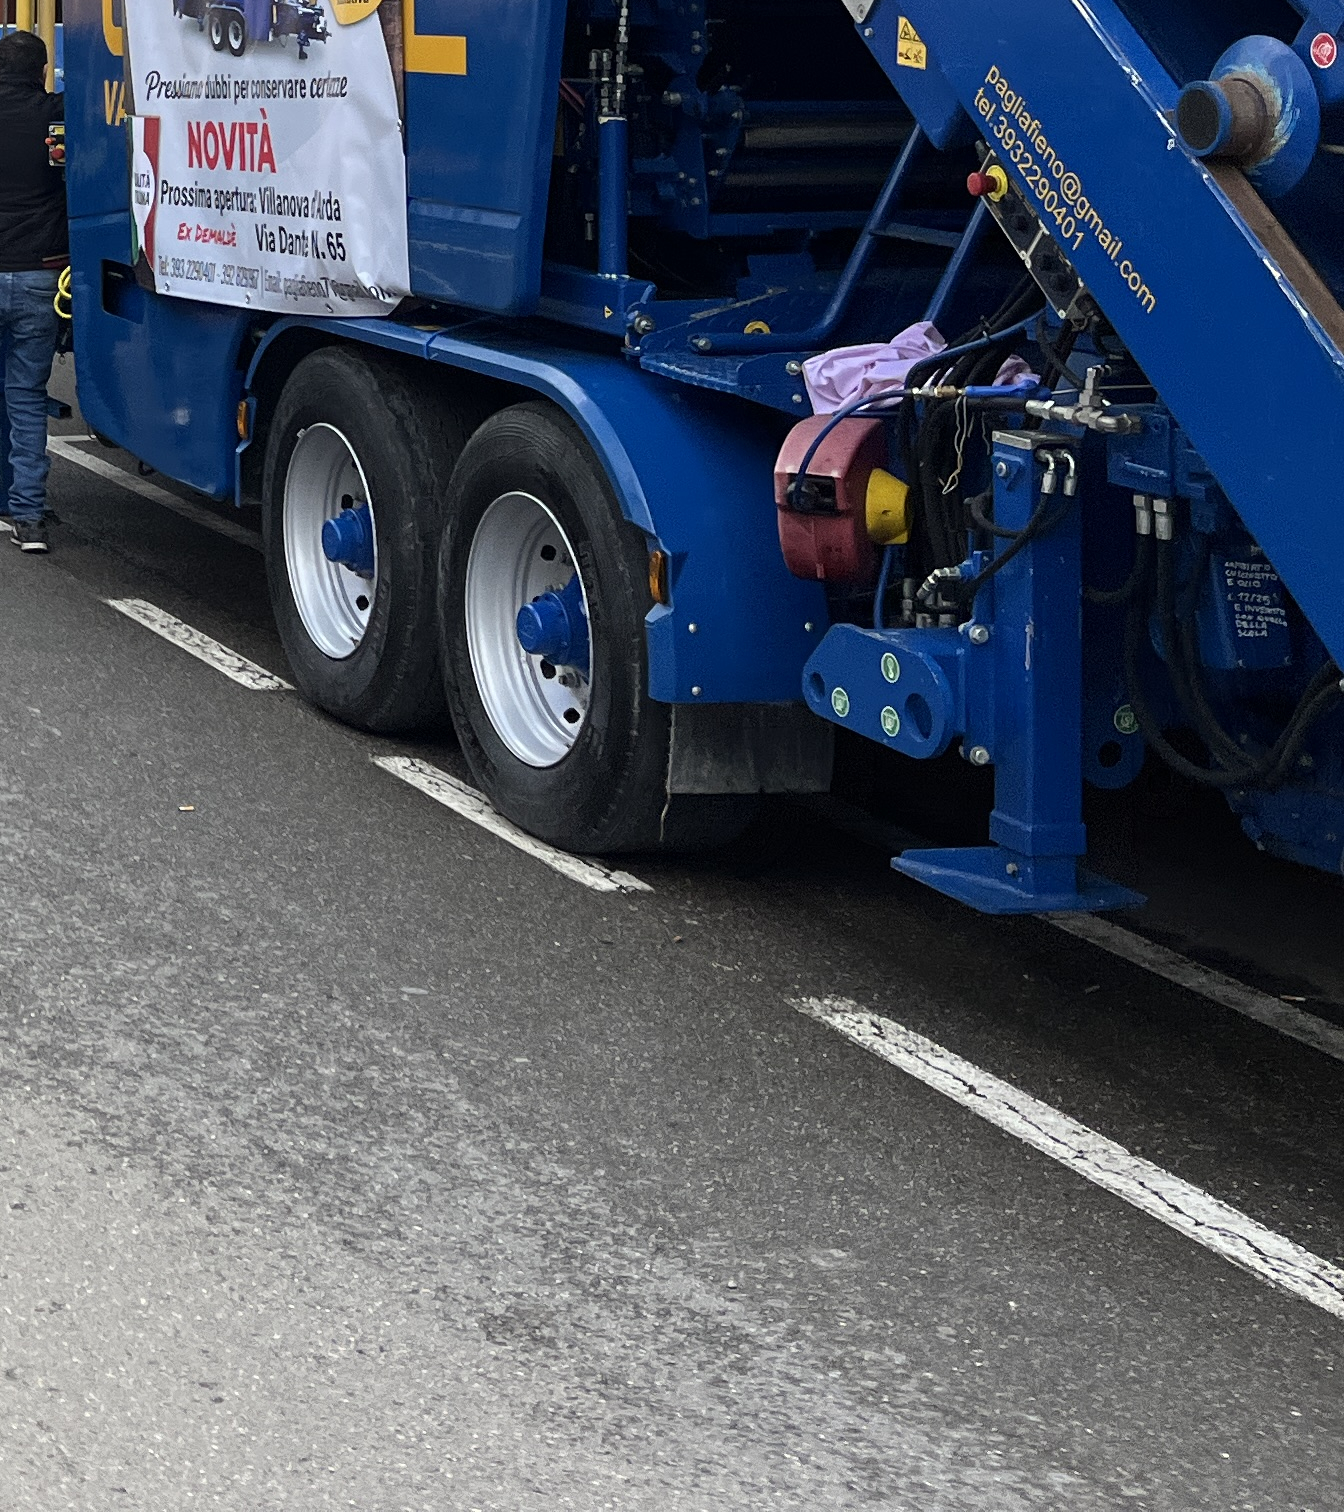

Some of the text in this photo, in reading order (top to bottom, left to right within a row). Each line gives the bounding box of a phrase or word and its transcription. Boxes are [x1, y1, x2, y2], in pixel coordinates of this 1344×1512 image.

[234, 79, 249, 105] per
[251, 78, 306, 99] conservare
[187, 108, 277, 174] NOVITÀ
[973, 87, 1084, 250] tel.3932290401
[984, 65, 1157, 314] pagliafieno@gmail.com
[160, 180, 212, 208] Prossima
[214, 187, 257, 216] apertura:
[258, 186, 308, 218] Villanova
[254, 223, 275, 252] Via
[326, 231, 346, 262] 65
